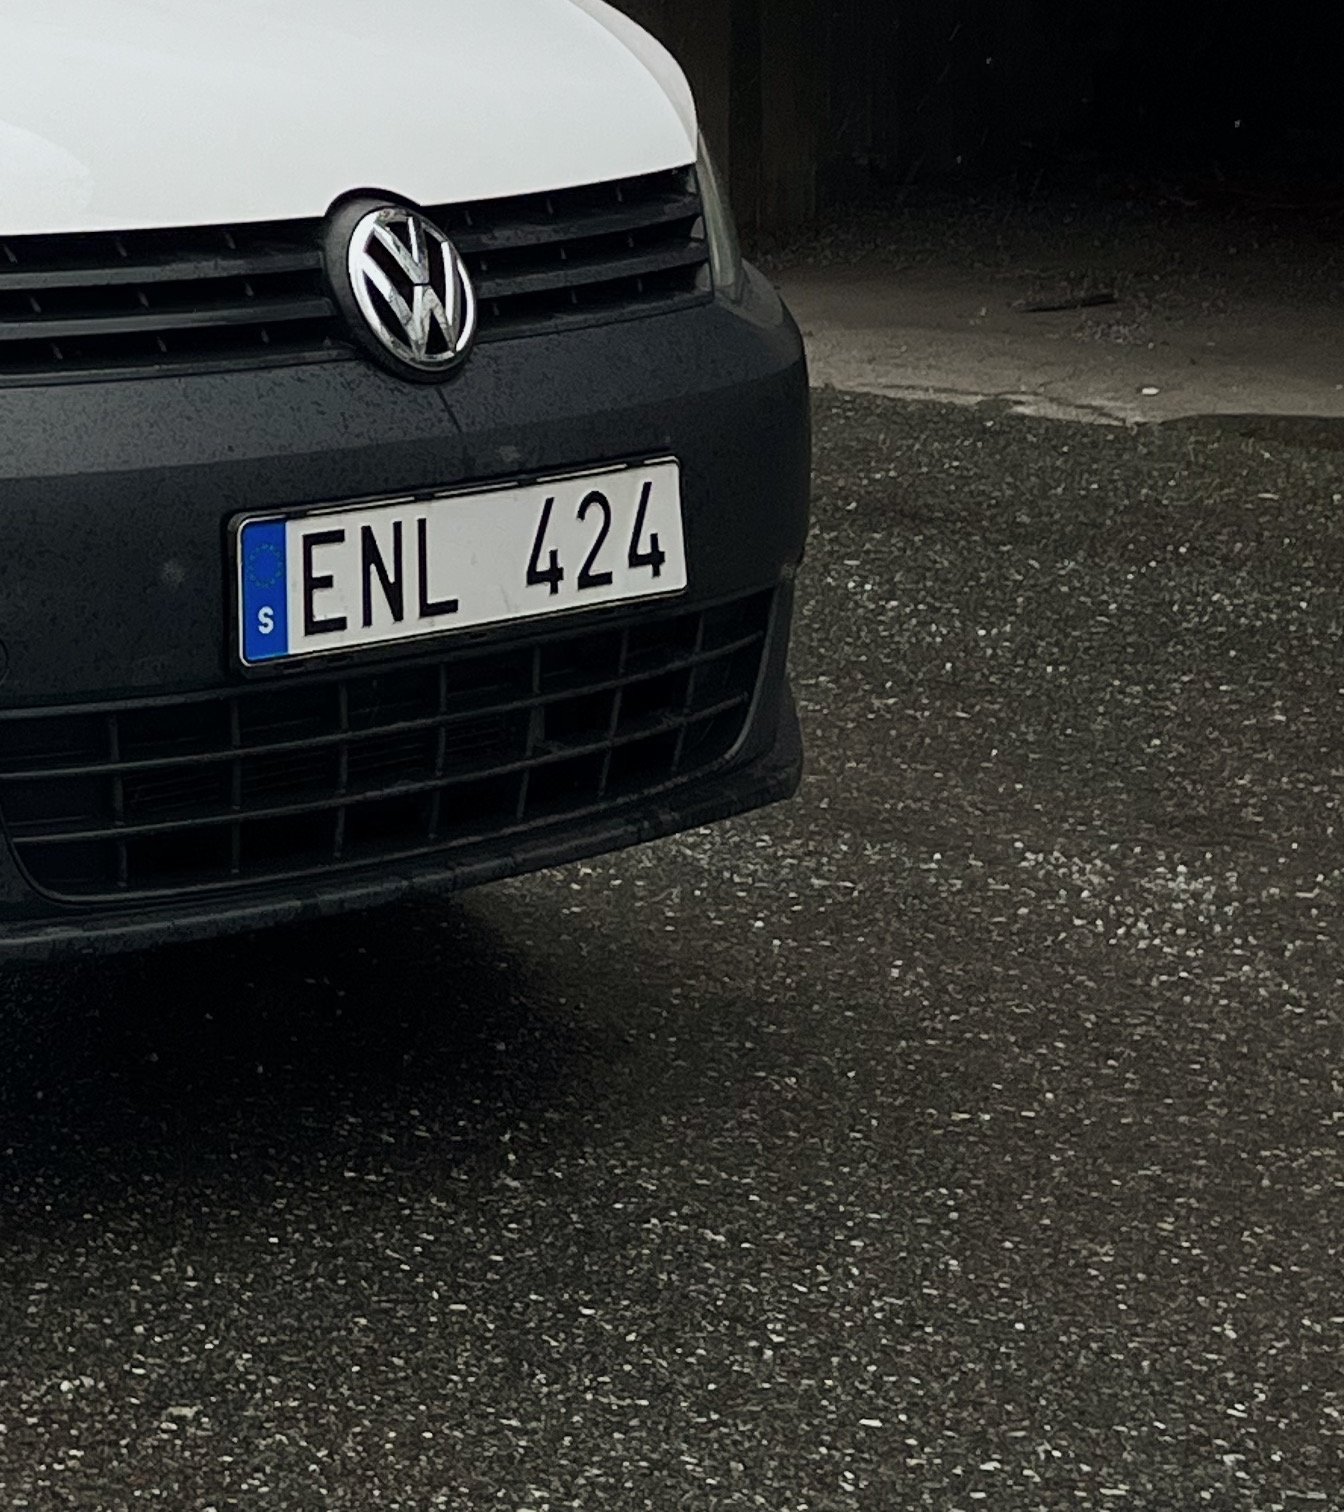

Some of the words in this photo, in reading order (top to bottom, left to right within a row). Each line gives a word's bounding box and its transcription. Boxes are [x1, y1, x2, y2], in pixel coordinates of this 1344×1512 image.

[302, 517, 459, 637] ENL
[525, 481, 666, 596] 424
[257, 605, 274, 635] S
